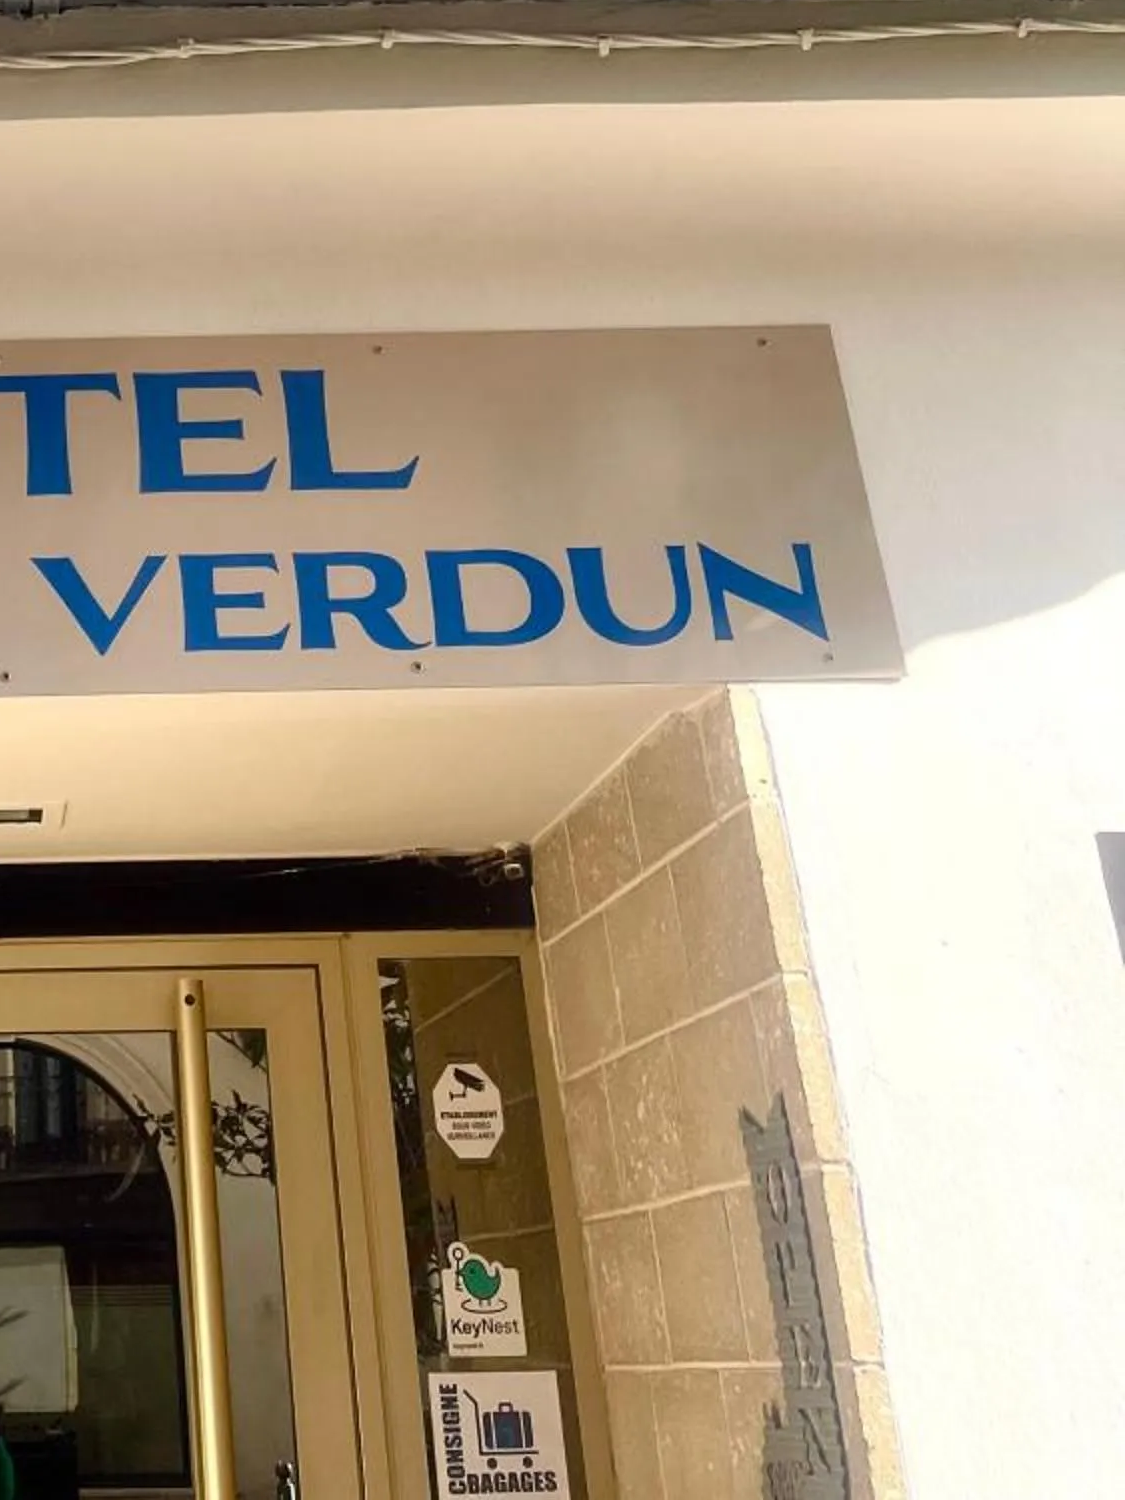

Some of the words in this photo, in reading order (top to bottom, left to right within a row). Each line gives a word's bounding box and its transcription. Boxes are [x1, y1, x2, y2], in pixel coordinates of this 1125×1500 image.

[30, 542, 830, 656] VERDUN
[450, 1317, 520, 1339] KeyNest
[439, 1383, 467, 1495] CONSIGNE
[466, 1470, 558, 1495] BAGAGES
